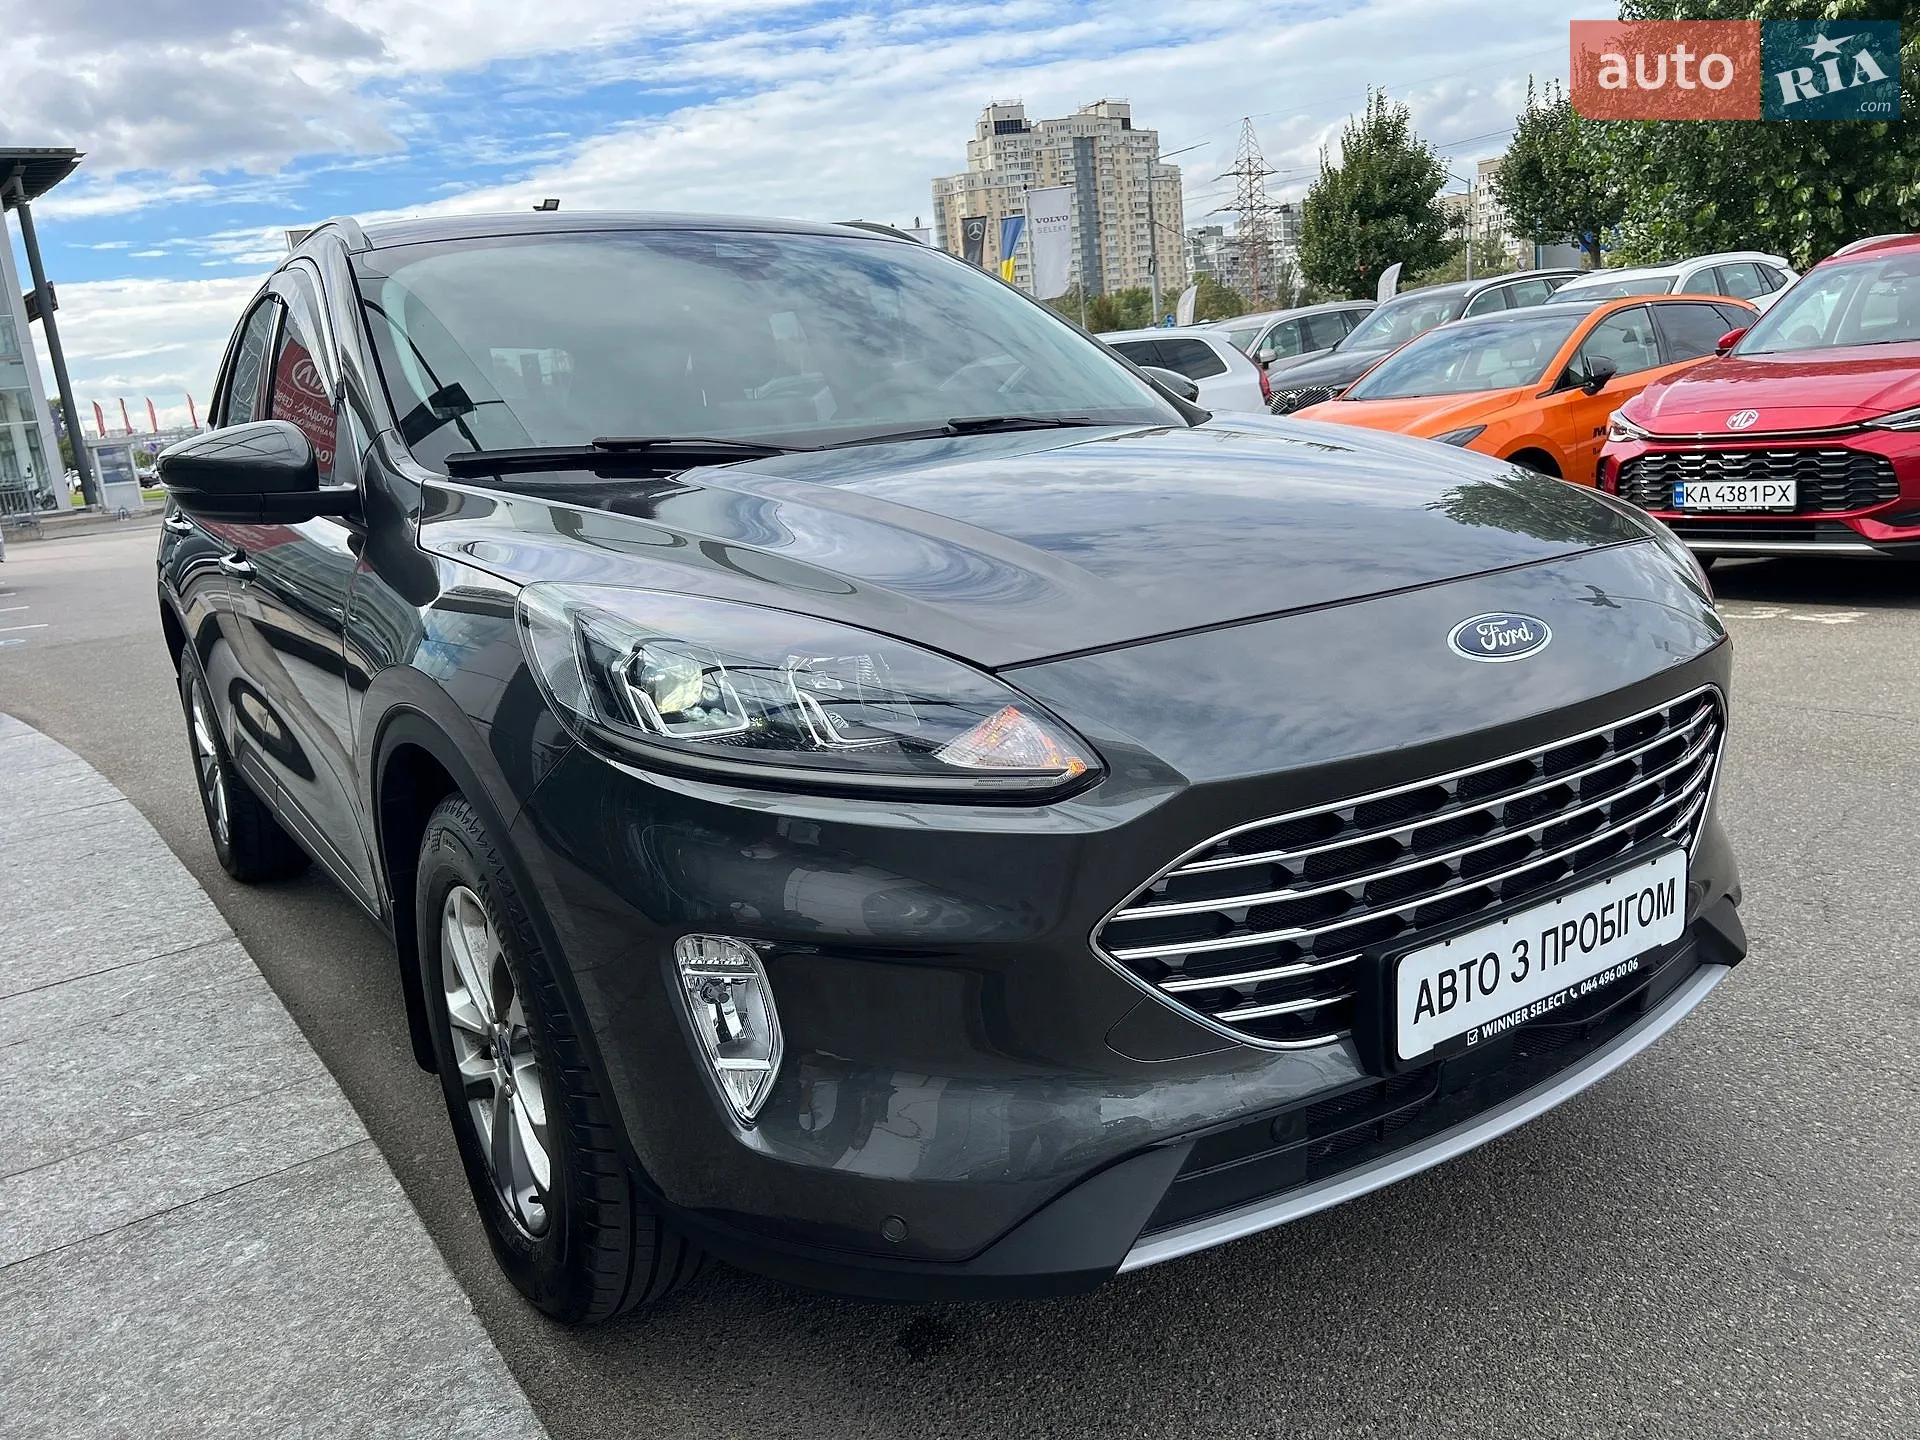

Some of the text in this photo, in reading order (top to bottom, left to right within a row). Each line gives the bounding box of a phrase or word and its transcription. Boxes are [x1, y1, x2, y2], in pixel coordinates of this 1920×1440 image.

[1035, 215, 1069, 224] VOLVO
[1037, 225, 1067, 234] SELEKT
[1728, 410, 1758, 429] MG
[1715, 485, 1758, 503] 4381
[1476, 619, 1534, 651] Ford
[1413, 952, 1500, 1024] АВТО
[1540, 877, 1676, 972] ПРОБІГОМ
[1482, 957, 1639, 1039] WINNER SELECT 044 496 00 06
